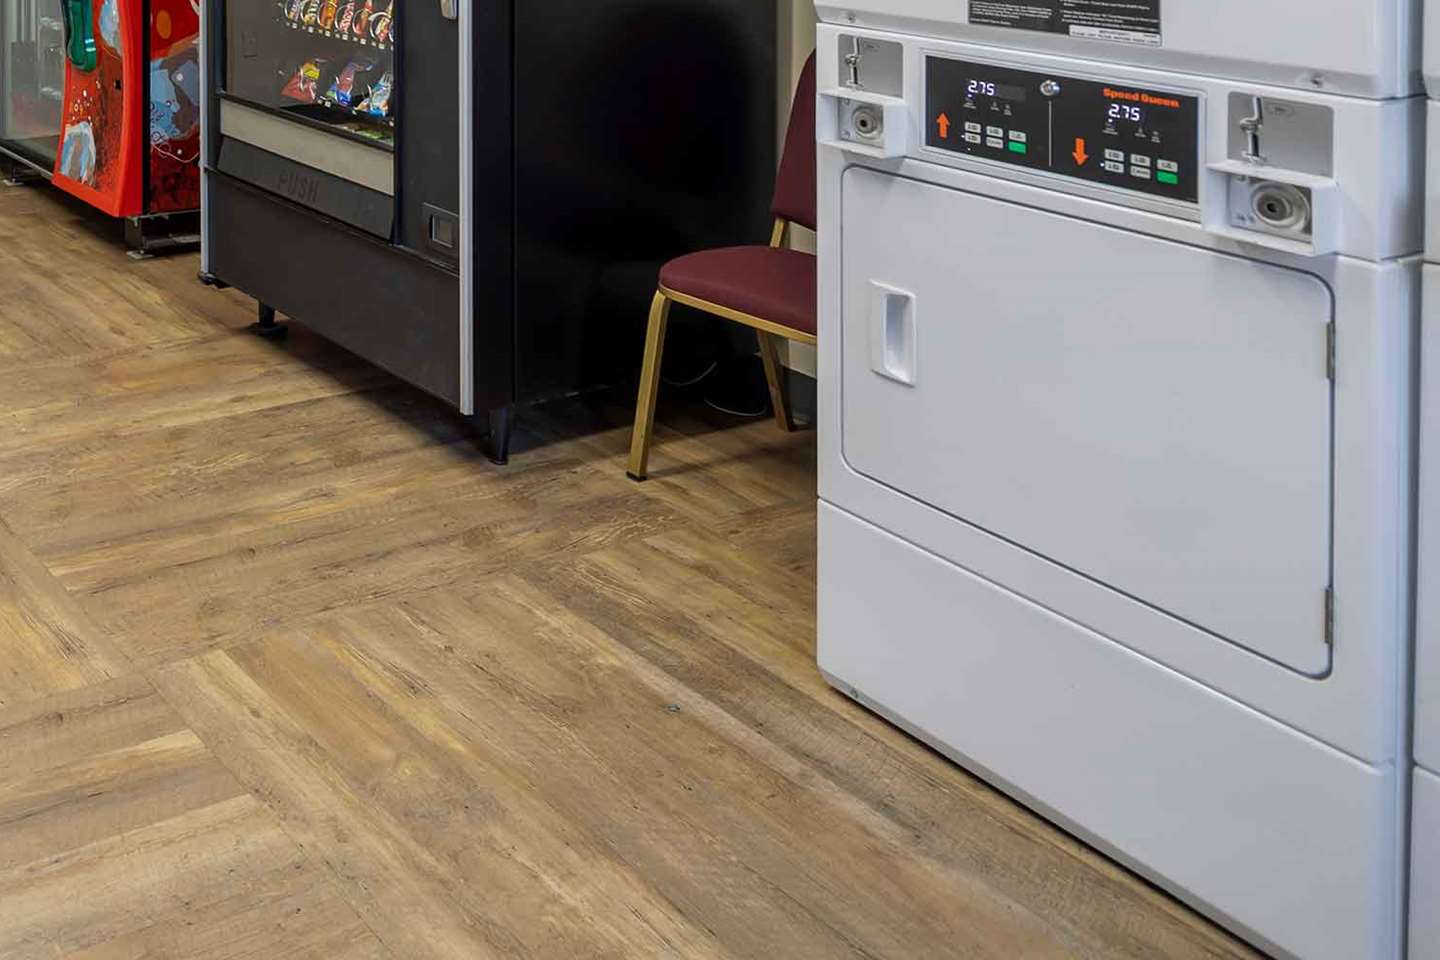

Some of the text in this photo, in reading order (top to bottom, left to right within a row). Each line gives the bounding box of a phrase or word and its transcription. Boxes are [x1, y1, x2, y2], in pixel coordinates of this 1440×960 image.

[1103, 87, 1180, 109] Speed Queen
[1108, 103, 1140, 121] 2.75
[277, 171, 320, 203] PUSH
